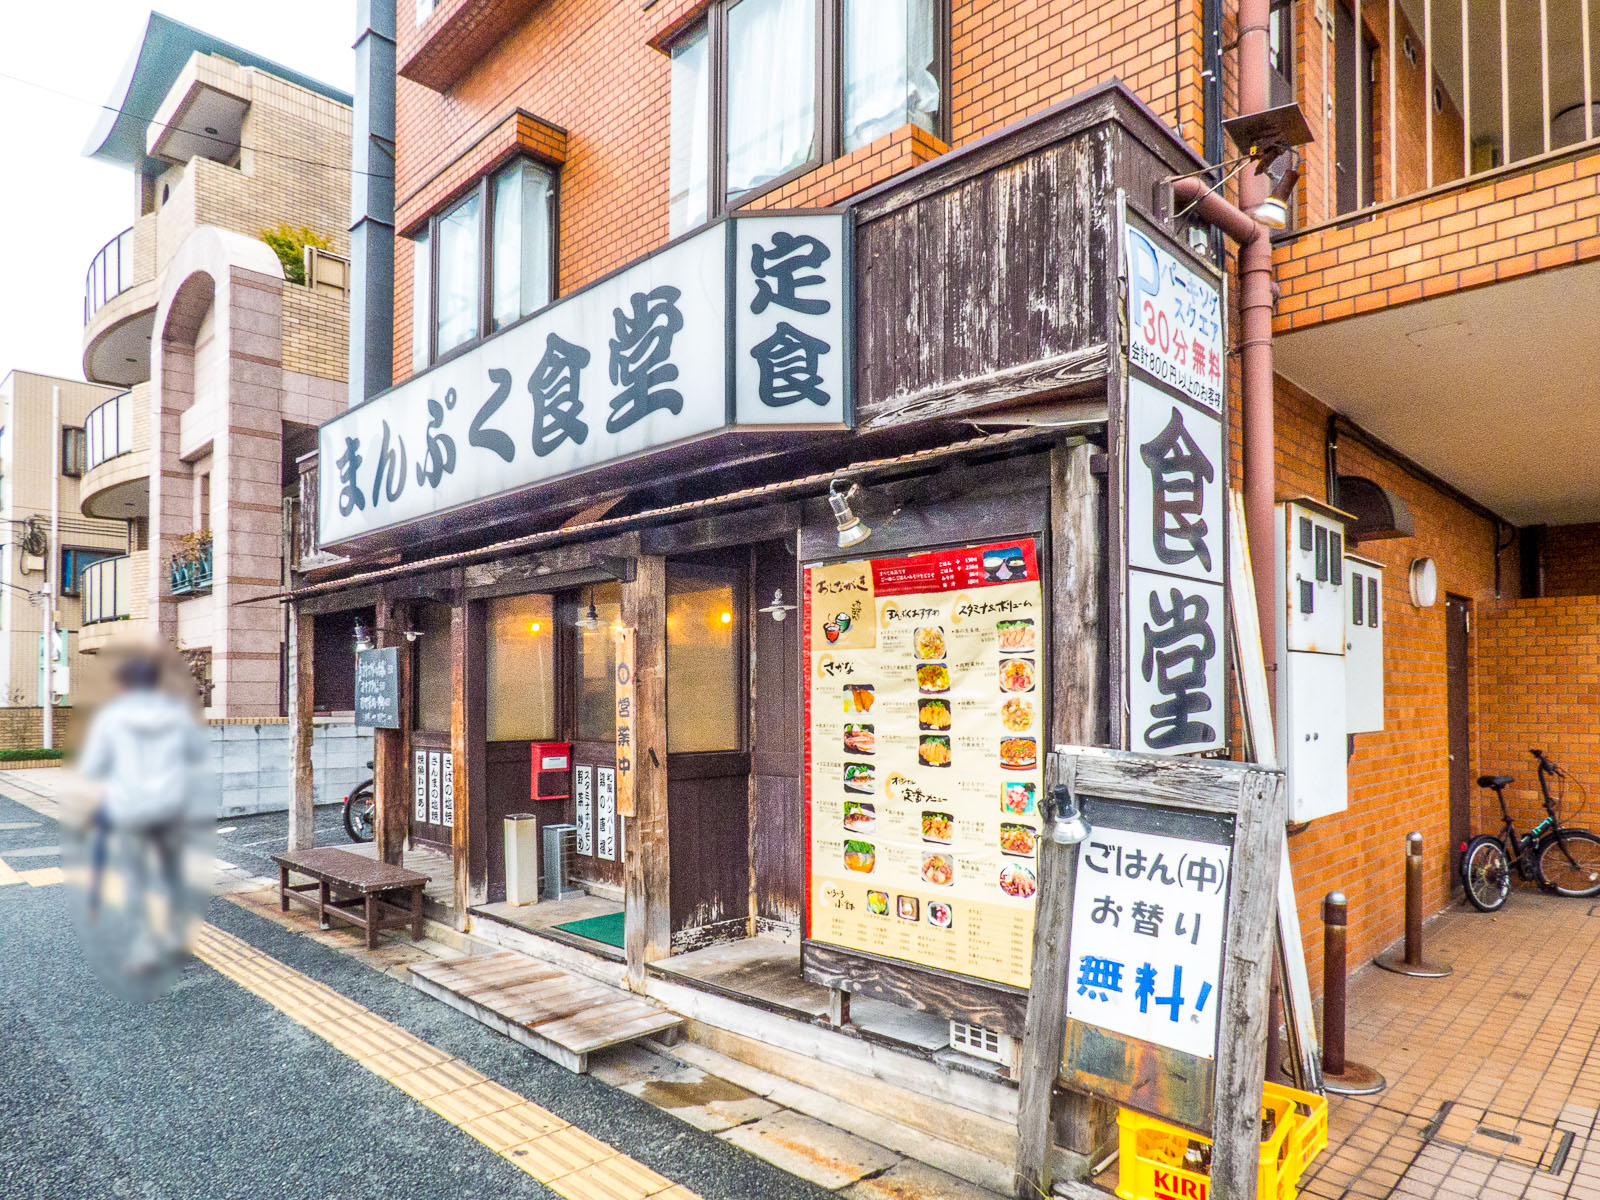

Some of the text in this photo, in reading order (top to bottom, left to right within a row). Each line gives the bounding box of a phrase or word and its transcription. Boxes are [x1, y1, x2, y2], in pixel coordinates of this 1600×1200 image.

[1129, 229, 1160, 327] P
[1161, 262, 1218, 316] パーキング
[749, 231, 831, 407] 定食
[1143, 300, 1221, 387] 30分無料
[1174, 297, 1218, 343] スクエア
[336, 285, 684, 517] まんぷく食堂
[816, 575, 868, 594] おしながき
[1139, 406, 1216, 749] 食堂
[823, 661, 854, 677] さかな
[1084, 841, 1225, 895] ごはん(中)
[1091, 895, 1202, 945] お替り
[1154, 1169, 1206, 1200] KIRI
